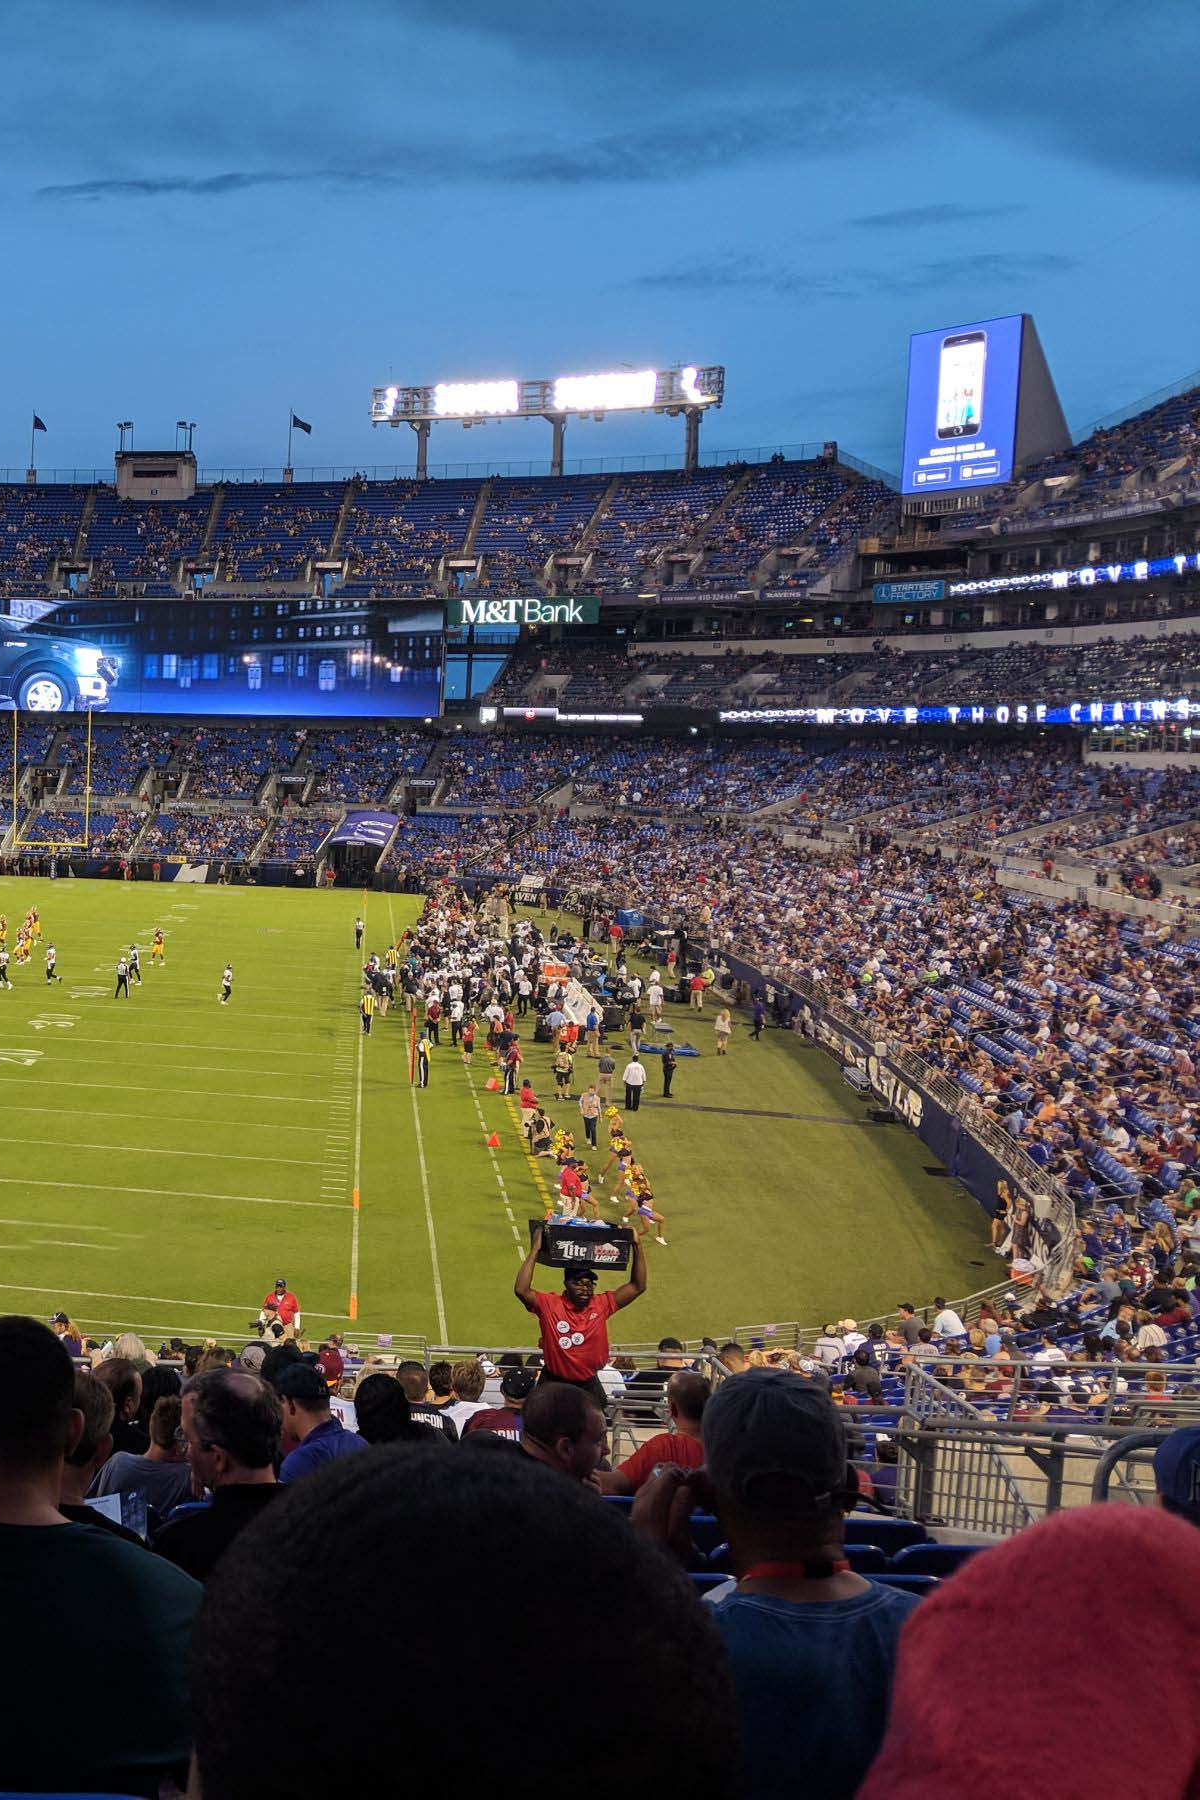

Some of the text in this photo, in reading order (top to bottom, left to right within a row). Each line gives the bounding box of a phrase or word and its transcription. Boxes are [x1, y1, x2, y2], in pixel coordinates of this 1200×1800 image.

[1053, 561, 1148, 588] MOVE
[891, 582, 939, 592] STRATEGIC
[766, 591, 801, 599] RAVENS
[890, 590, 937, 601] FACTORY
[460, 598, 584, 624] M&T Bank
[817, 698, 1189, 724] MOVE THOSE CHAINS
[281, 775, 307, 784] GEICO
[410, 778, 437, 787] GEICO
[27, 1013, 83, 1028] 30
[562, 1243, 588, 1259] Lite
[594, 1254, 619, 1263] LIGHT
